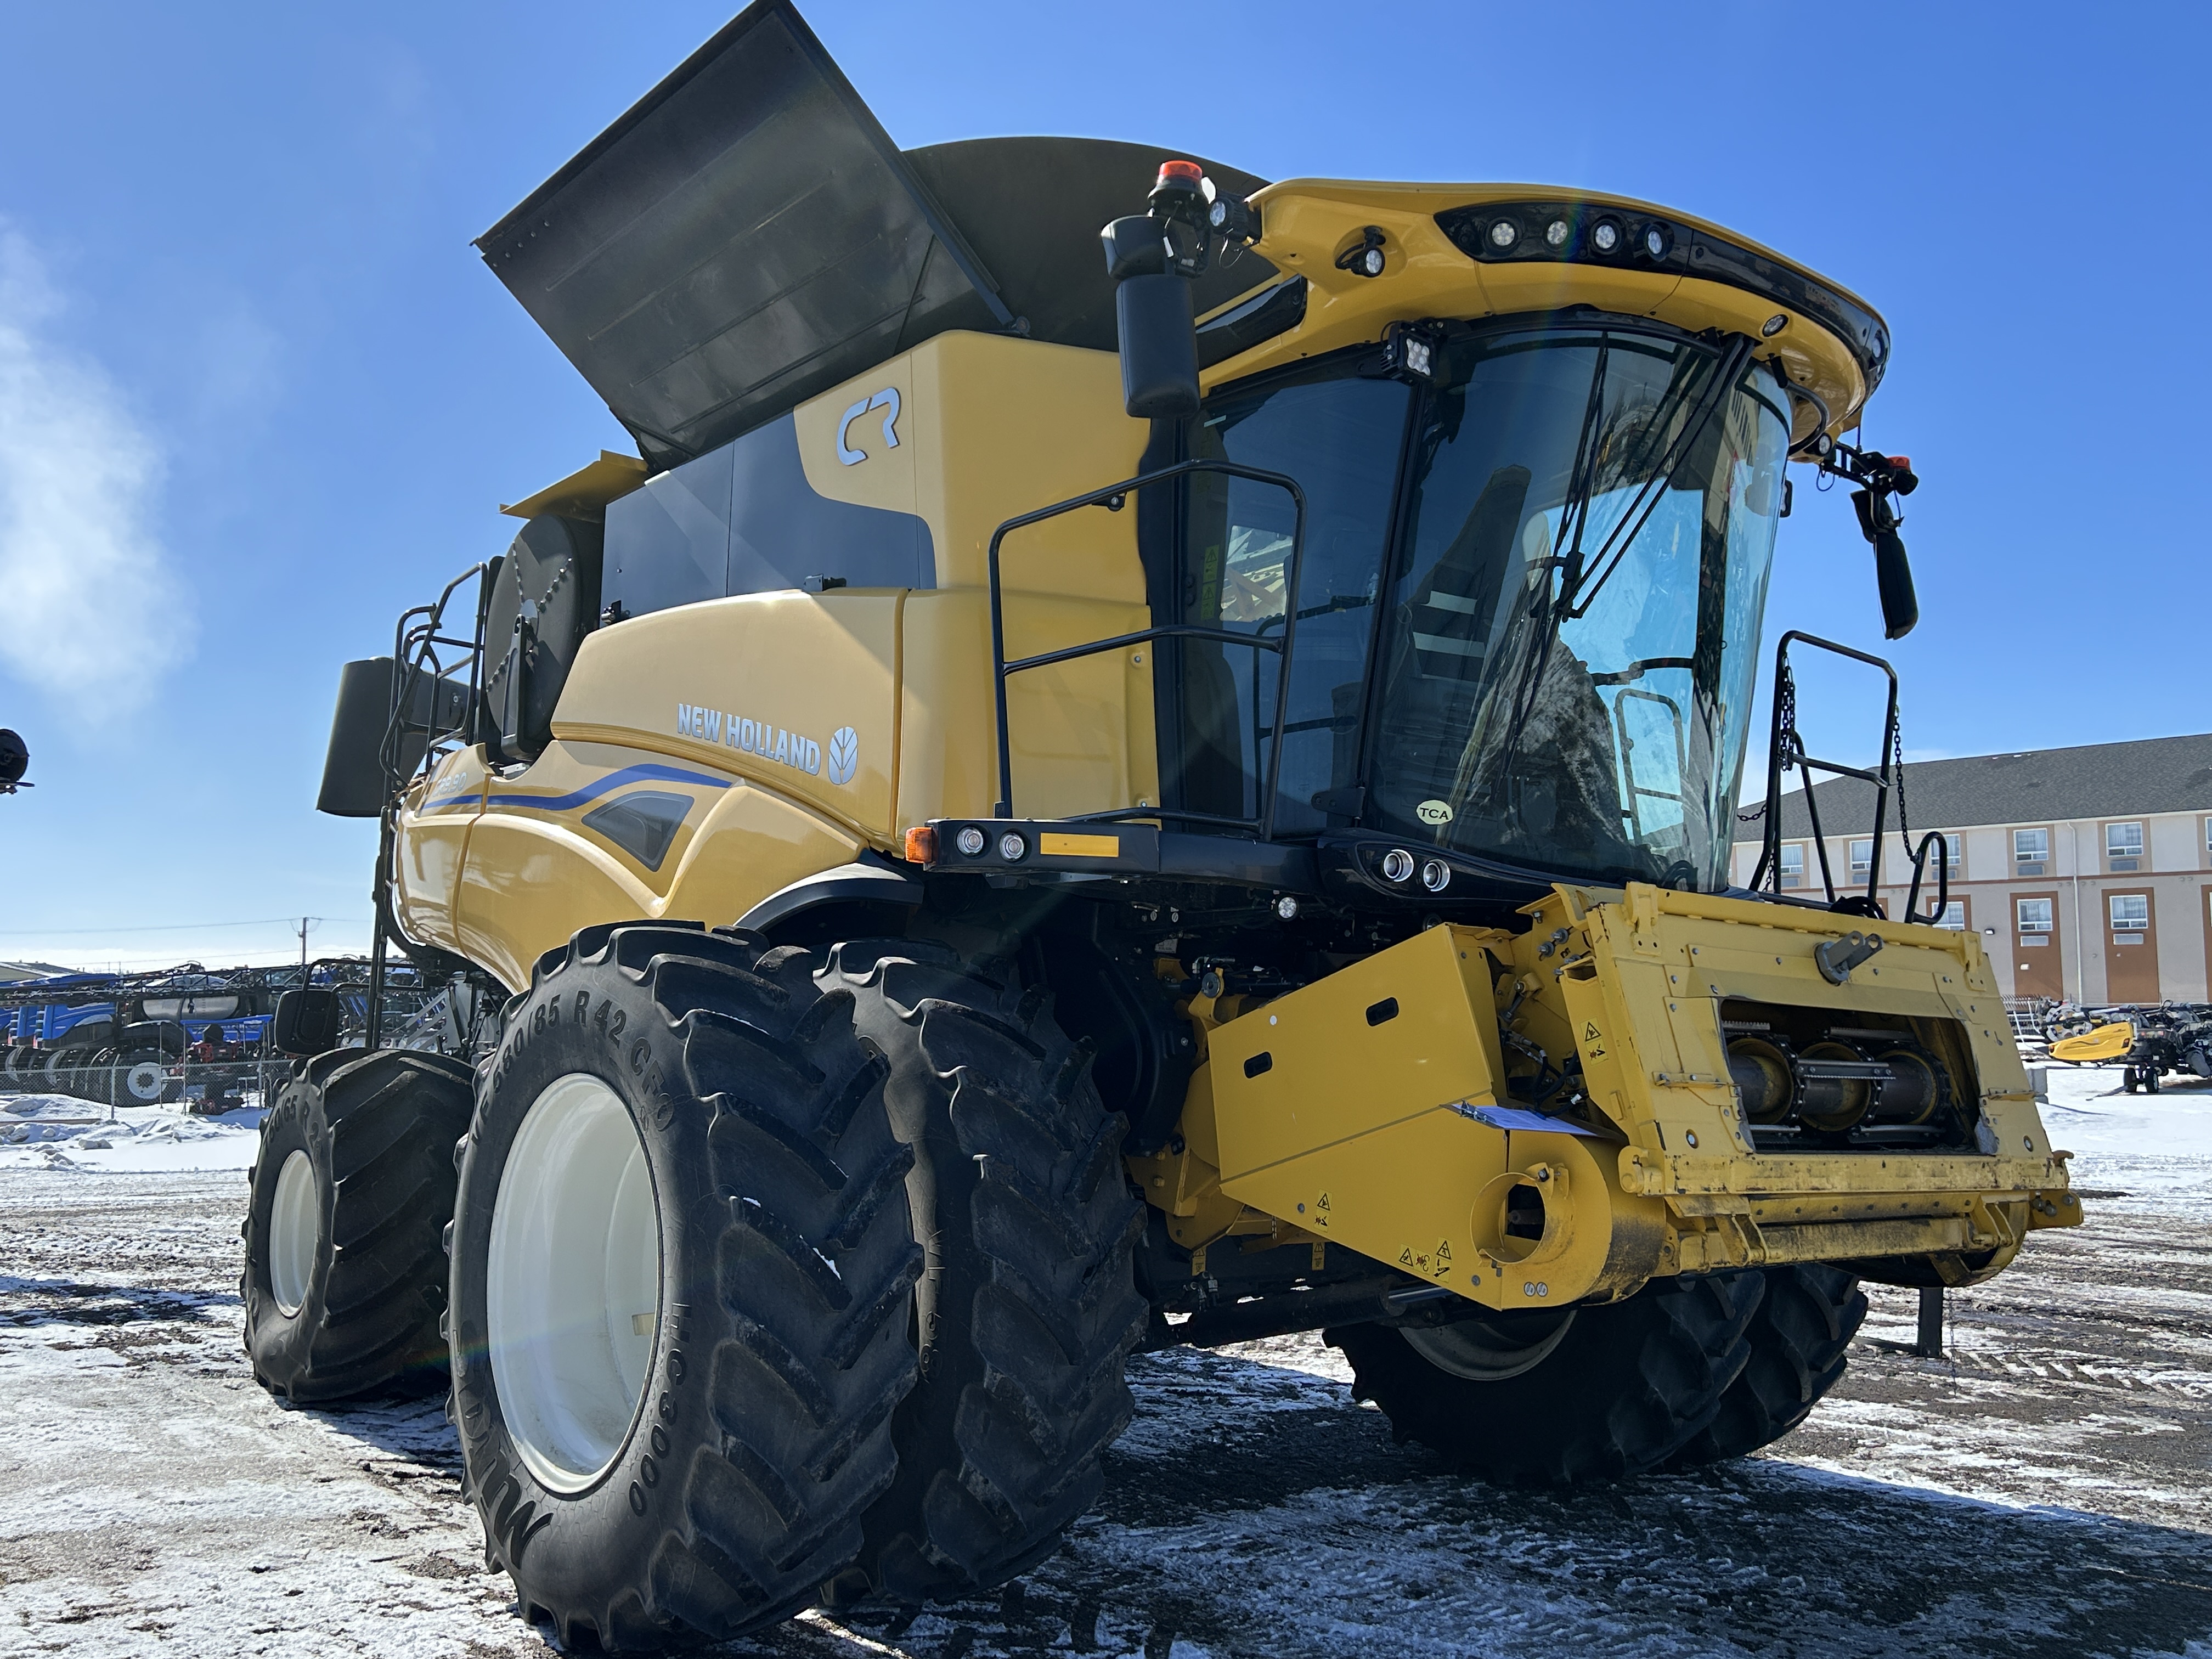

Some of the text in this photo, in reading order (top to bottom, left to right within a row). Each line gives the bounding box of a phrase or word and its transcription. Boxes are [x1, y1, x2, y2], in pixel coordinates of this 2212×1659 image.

[837, 387, 901, 466] CR
[678, 703, 821, 776] NEW HOLLAND
[1420, 807, 1449, 820] TCA
[493, 994, 561, 1094] 580/85
